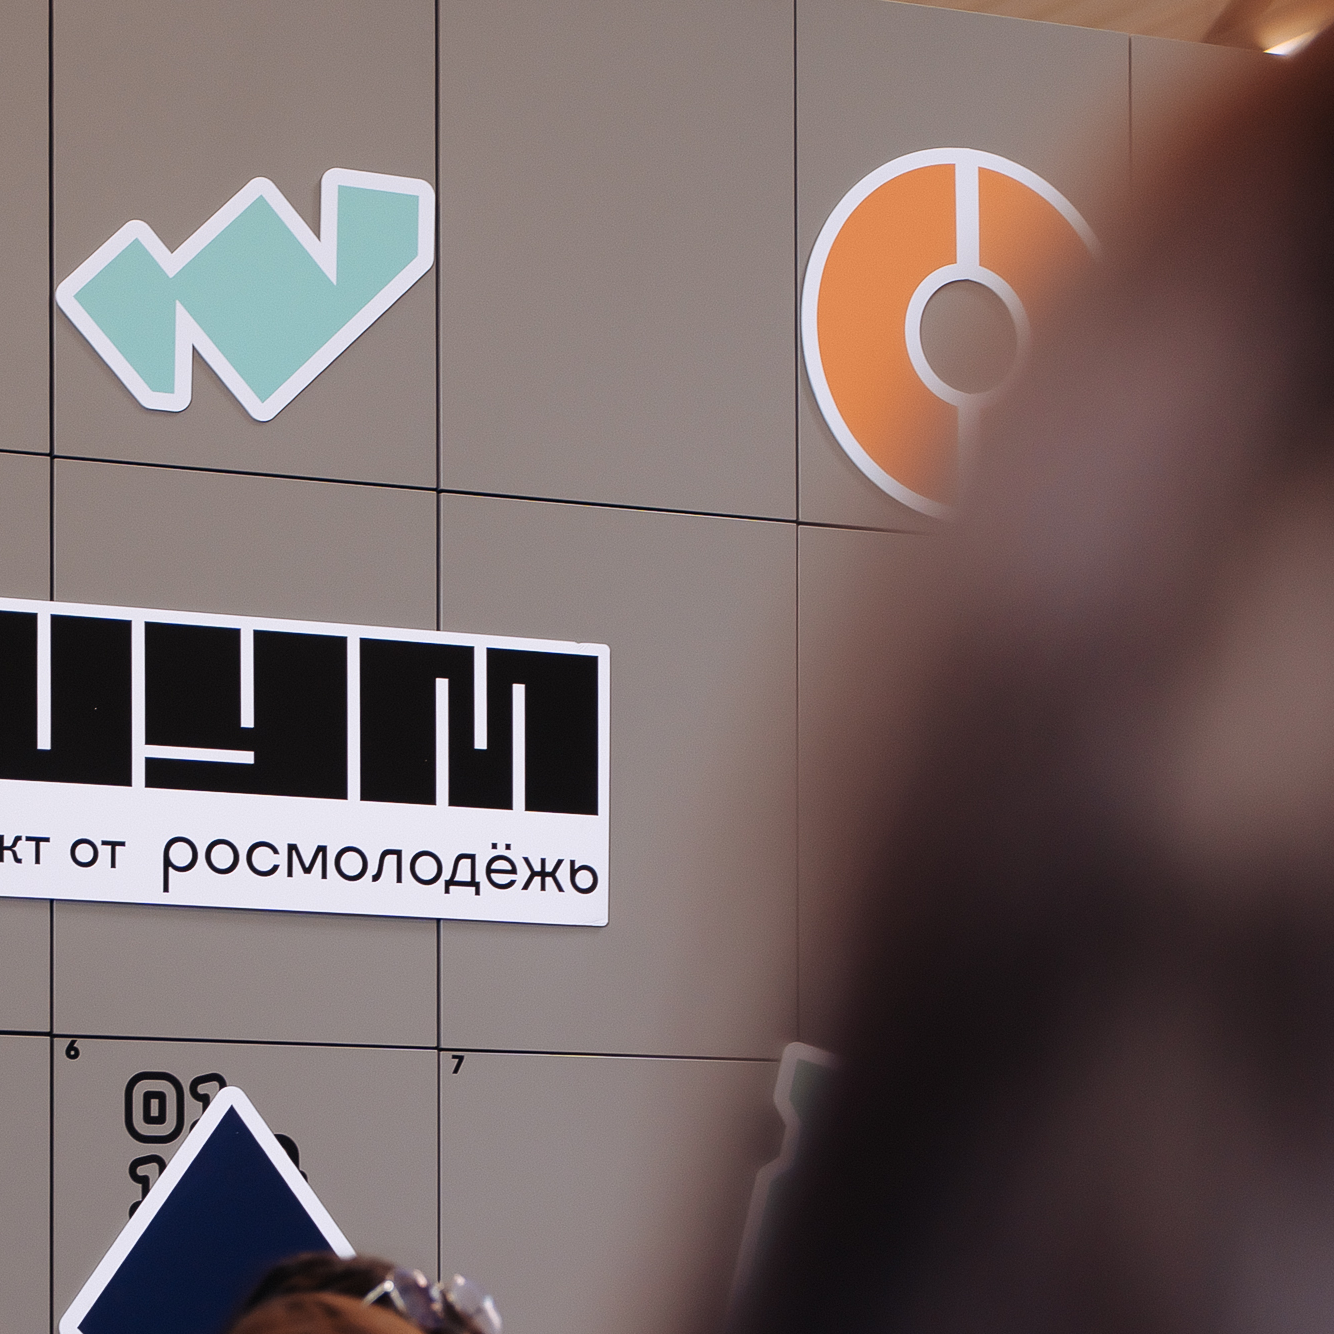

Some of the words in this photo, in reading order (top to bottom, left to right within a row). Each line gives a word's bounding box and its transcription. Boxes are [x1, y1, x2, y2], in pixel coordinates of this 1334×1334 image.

[70, 838, 127, 869] от
[162, 836, 600, 897] росмолодёжь
[64, 1039, 80, 1060] 6
[451, 1054, 465, 1075] 7
